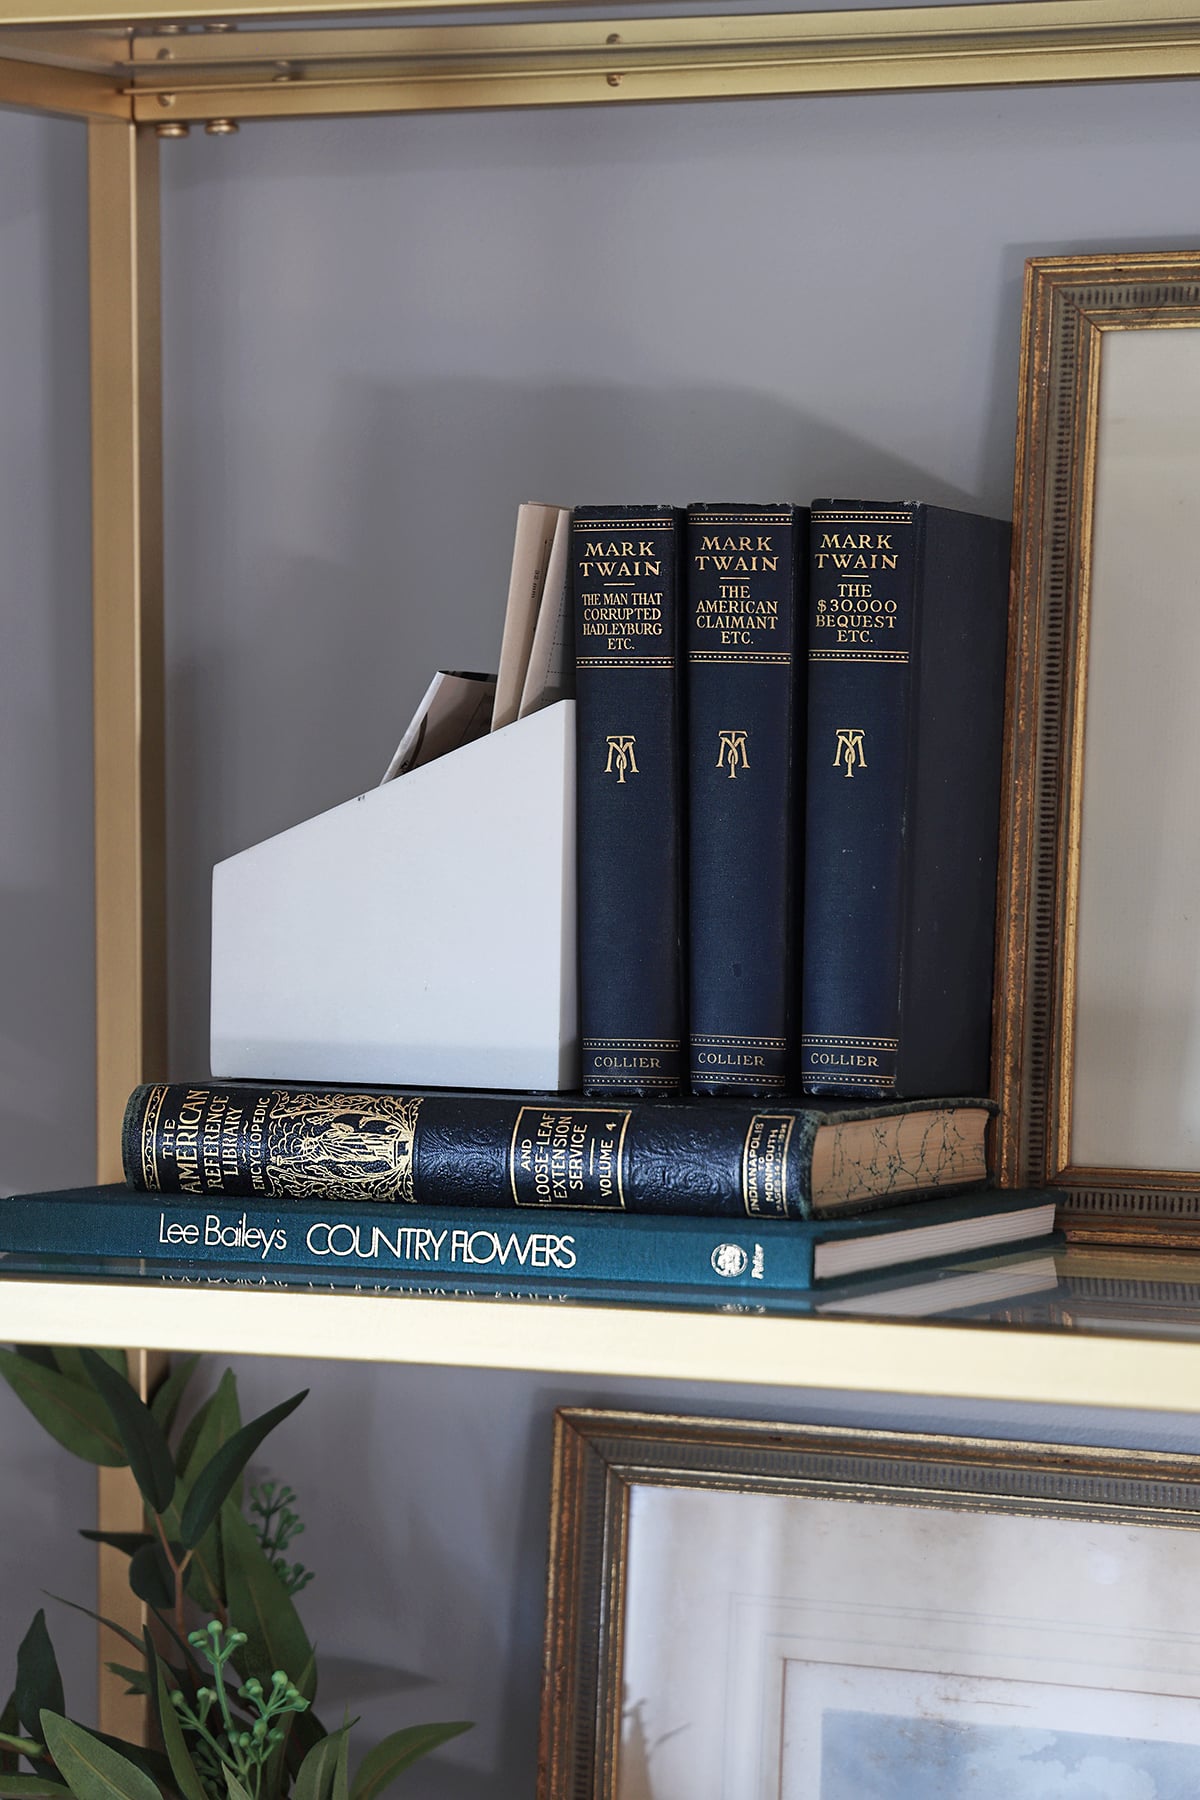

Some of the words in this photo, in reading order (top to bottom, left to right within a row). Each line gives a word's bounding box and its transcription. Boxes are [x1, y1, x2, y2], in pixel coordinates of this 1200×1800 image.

[584, 541, 656, 557] MARK
[700, 536, 773, 551] MARK
[820, 534, 893, 550] MARK
[579, 561, 662, 577] TWAIN
[694, 556, 779, 572] TWAIN
[814, 553, 899, 570] TWAIN
[719, 585, 751, 599] THE
[837, 583, 872, 598] THE
[582, 593, 601, 606] THE
[603, 593, 628, 606] MAN
[631, 592, 663, 606] THAT
[695, 600, 778, 614] AMERICAN
[817, 599, 898, 615] $30,000
[583, 607, 662, 621] CORRUPTED
[815, 614, 897, 629] BEQUEST
[583, 622, 663, 636] HADLEYBURG
[696, 615, 779, 630] CLAIMANT
[607, 637, 635, 650] ETC.
[720, 631, 754, 645] ETC.
[836, 629, 874, 643] ETC.
[593, 1055, 662, 1070] COLLIER
[697, 1052, 765, 1067] COLLIER
[810, 1052, 879, 1068] COLLIER
[605, 1122, 617, 1131] 4
[162, 1119, 176, 1160] THE
[175, 1089, 210, 1194] AMERICAN
[203, 1095, 230, 1190] REFERENCE
[222, 1107, 244, 1176] LIBRARY
[249, 1097, 271, 1190] ENCYCLOPEDIC
[520, 1138, 532, 1172] AND
[535, 1112, 556, 1203] LOOSE-LEAF
[551, 1116, 573, 1199] EXTENSION
[568, 1124, 588, 1191] SERVICE
[599, 1139, 614, 1197] VOLUME
[748, 1122, 764, 1211] INDIANAPOLIS
[757, 1156, 765, 1171] TO
[764, 1129, 779, 1203] MONMOUTH
[159, 1212, 200, 1245] Lee
[204, 1212, 288, 1260] Bailey's
[306, 1223, 448, 1261] COUNTRY
[451, 1229, 577, 1269] FLOWERS
